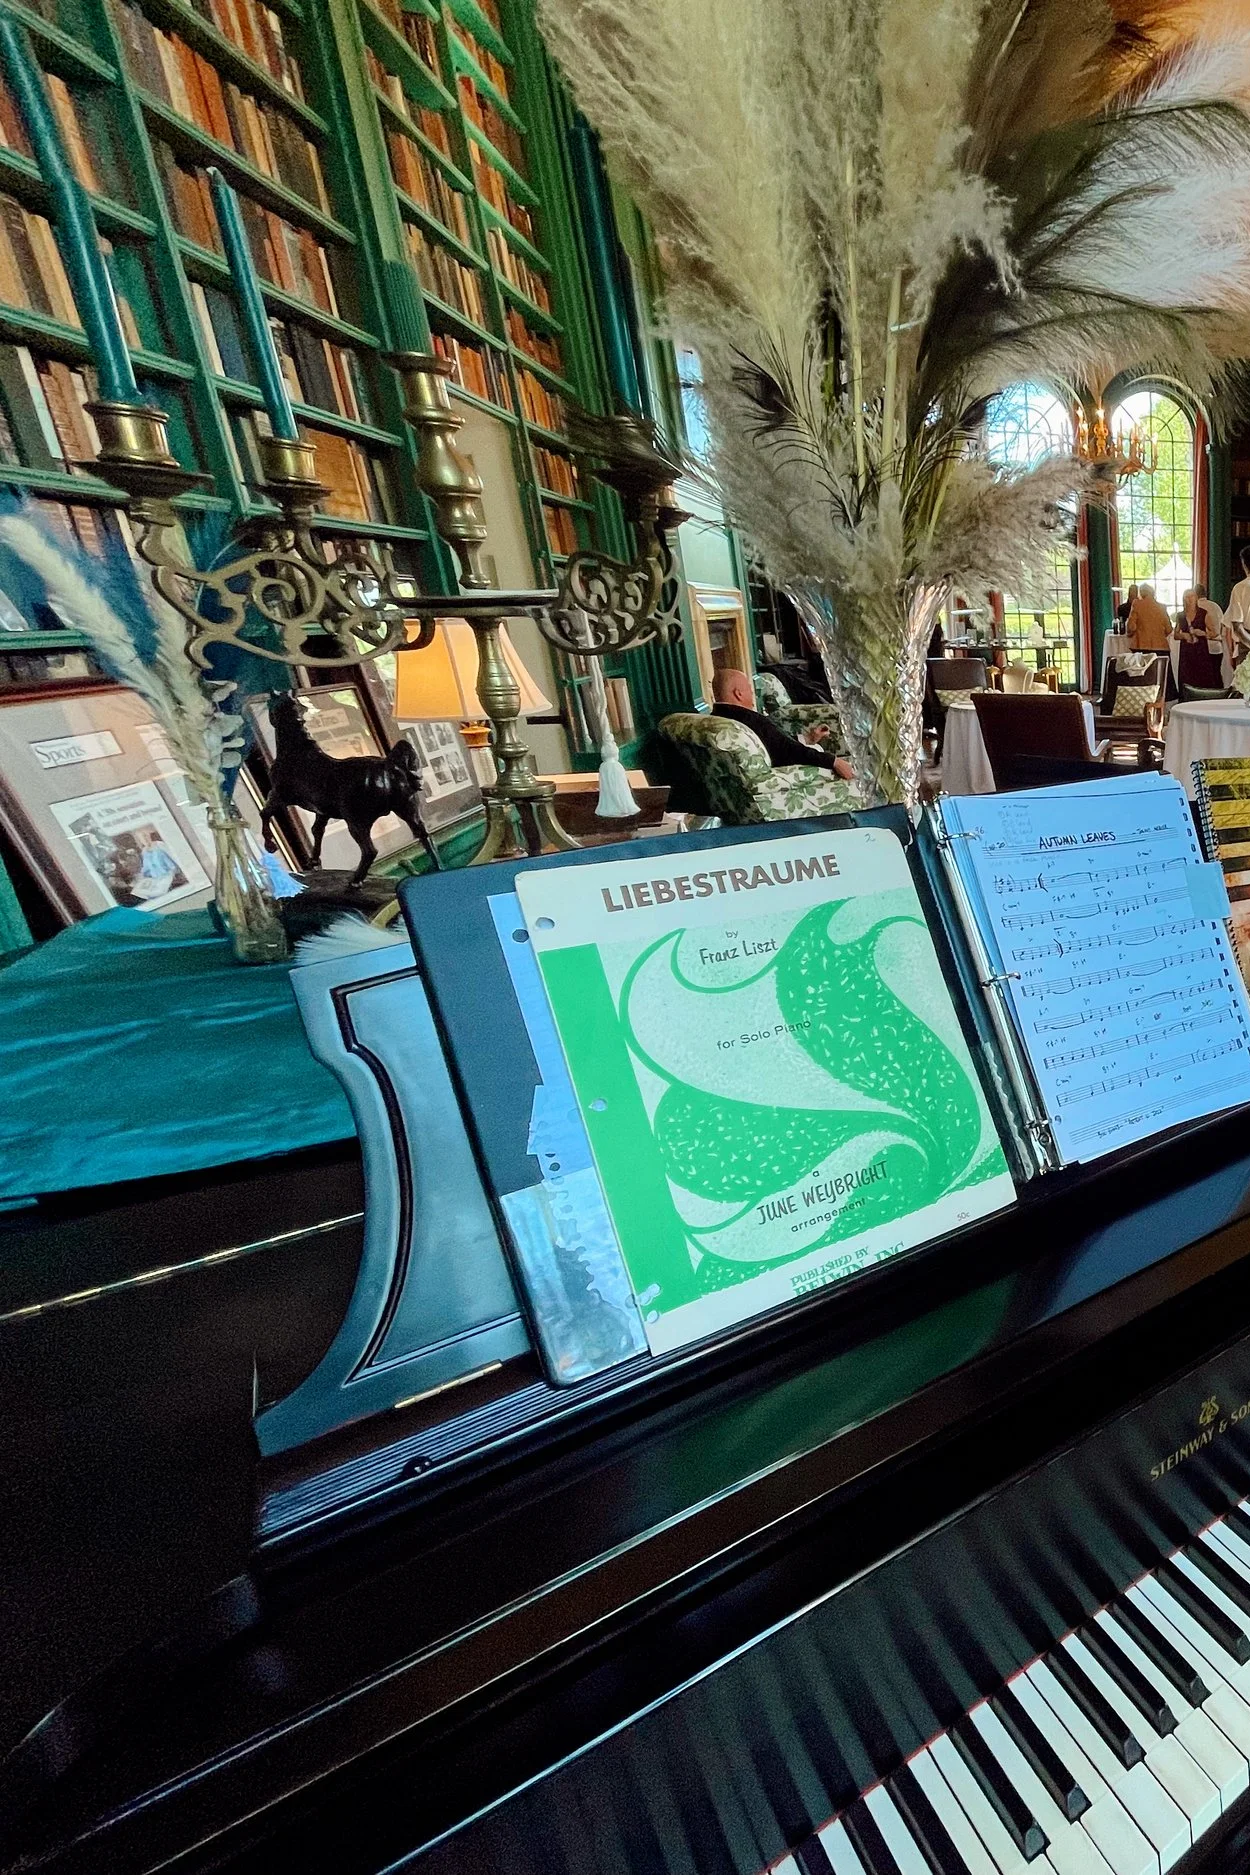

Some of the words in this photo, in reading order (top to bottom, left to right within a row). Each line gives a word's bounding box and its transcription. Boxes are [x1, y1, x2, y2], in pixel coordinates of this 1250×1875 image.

[1039, 834, 1078, 850] AUTUMN
[1082, 831, 1116, 843] LEAVES
[601, 854, 841, 913] LIEBESTRAUME
[699, 947, 740, 965] Franz
[742, 938, 779, 957] Liszt
[725, 930, 739, 940] by
[716, 1039, 735, 1051] for
[740, 1029, 771, 1044] Solo
[774, 1019, 812, 1036] Piano
[812, 1170, 820, 1178] a
[756, 1195, 799, 1226] JUNE
[801, 1160, 889, 1208] WEYBRIGHT
[790, 1197, 867, 1233] arrangement
[790, 1253, 853, 1288] PUBLISHED
[855, 1245, 870, 1260] BY
[1150, 1427, 1214, 1482] STEINWAY
[1218, 1418, 1228, 1434] &
